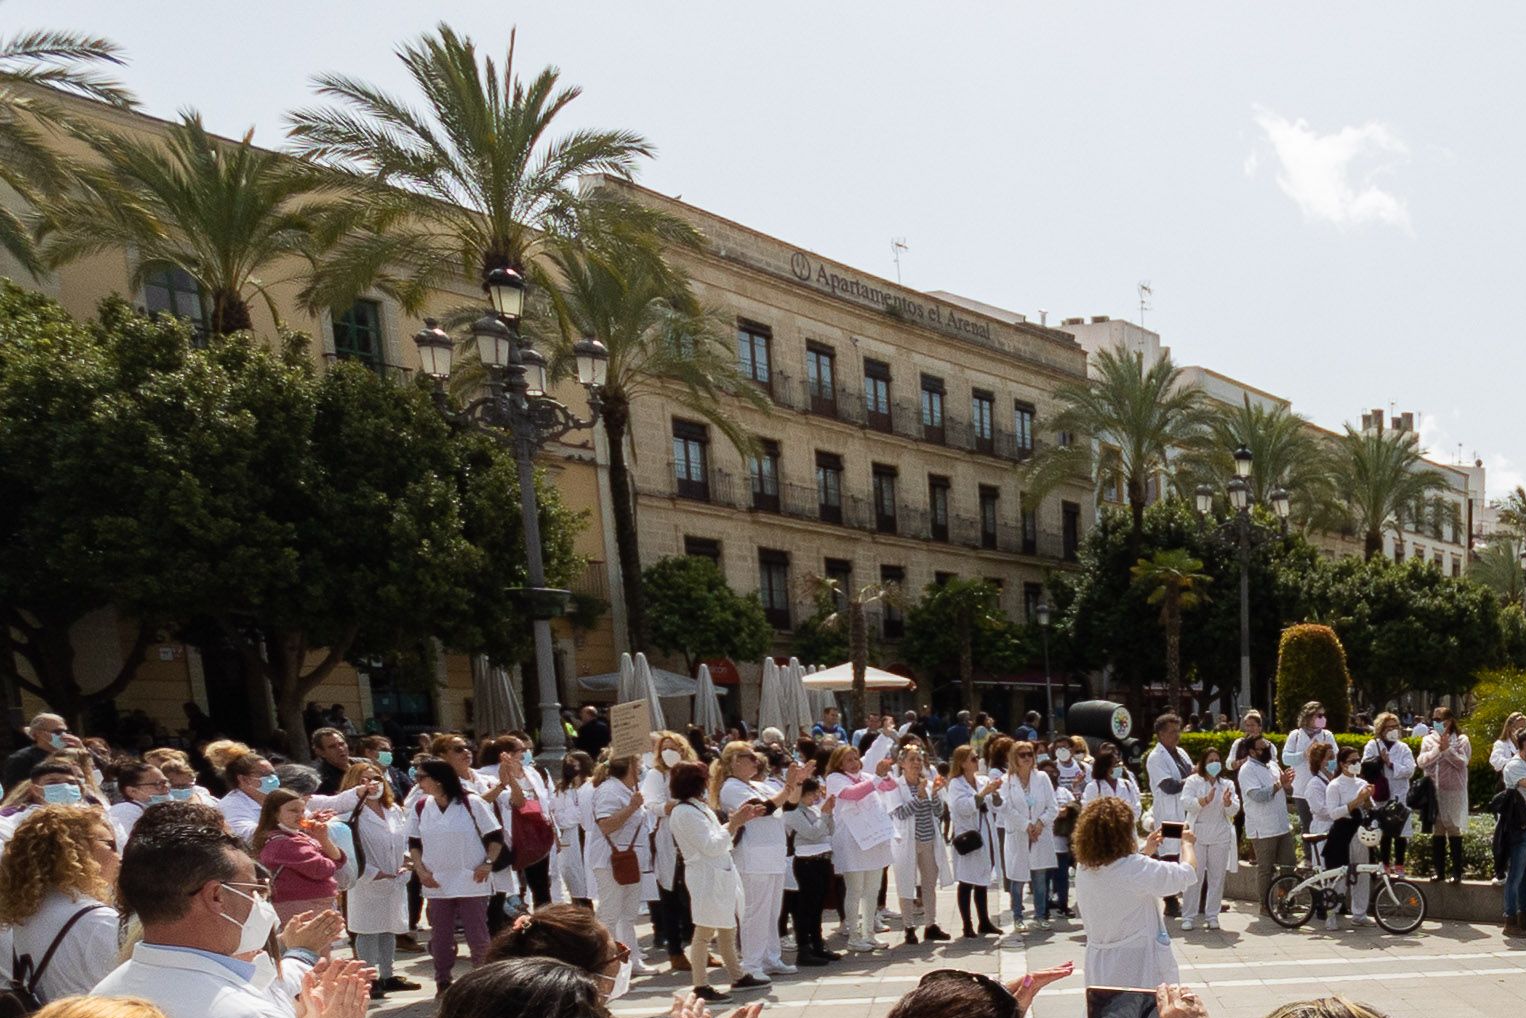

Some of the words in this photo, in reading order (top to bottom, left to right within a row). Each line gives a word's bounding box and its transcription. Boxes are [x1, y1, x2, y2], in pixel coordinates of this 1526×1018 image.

[816, 263, 925, 320] Apartamentos
[928, 303, 943, 327] el
[946, 310, 991, 340] Arenal
